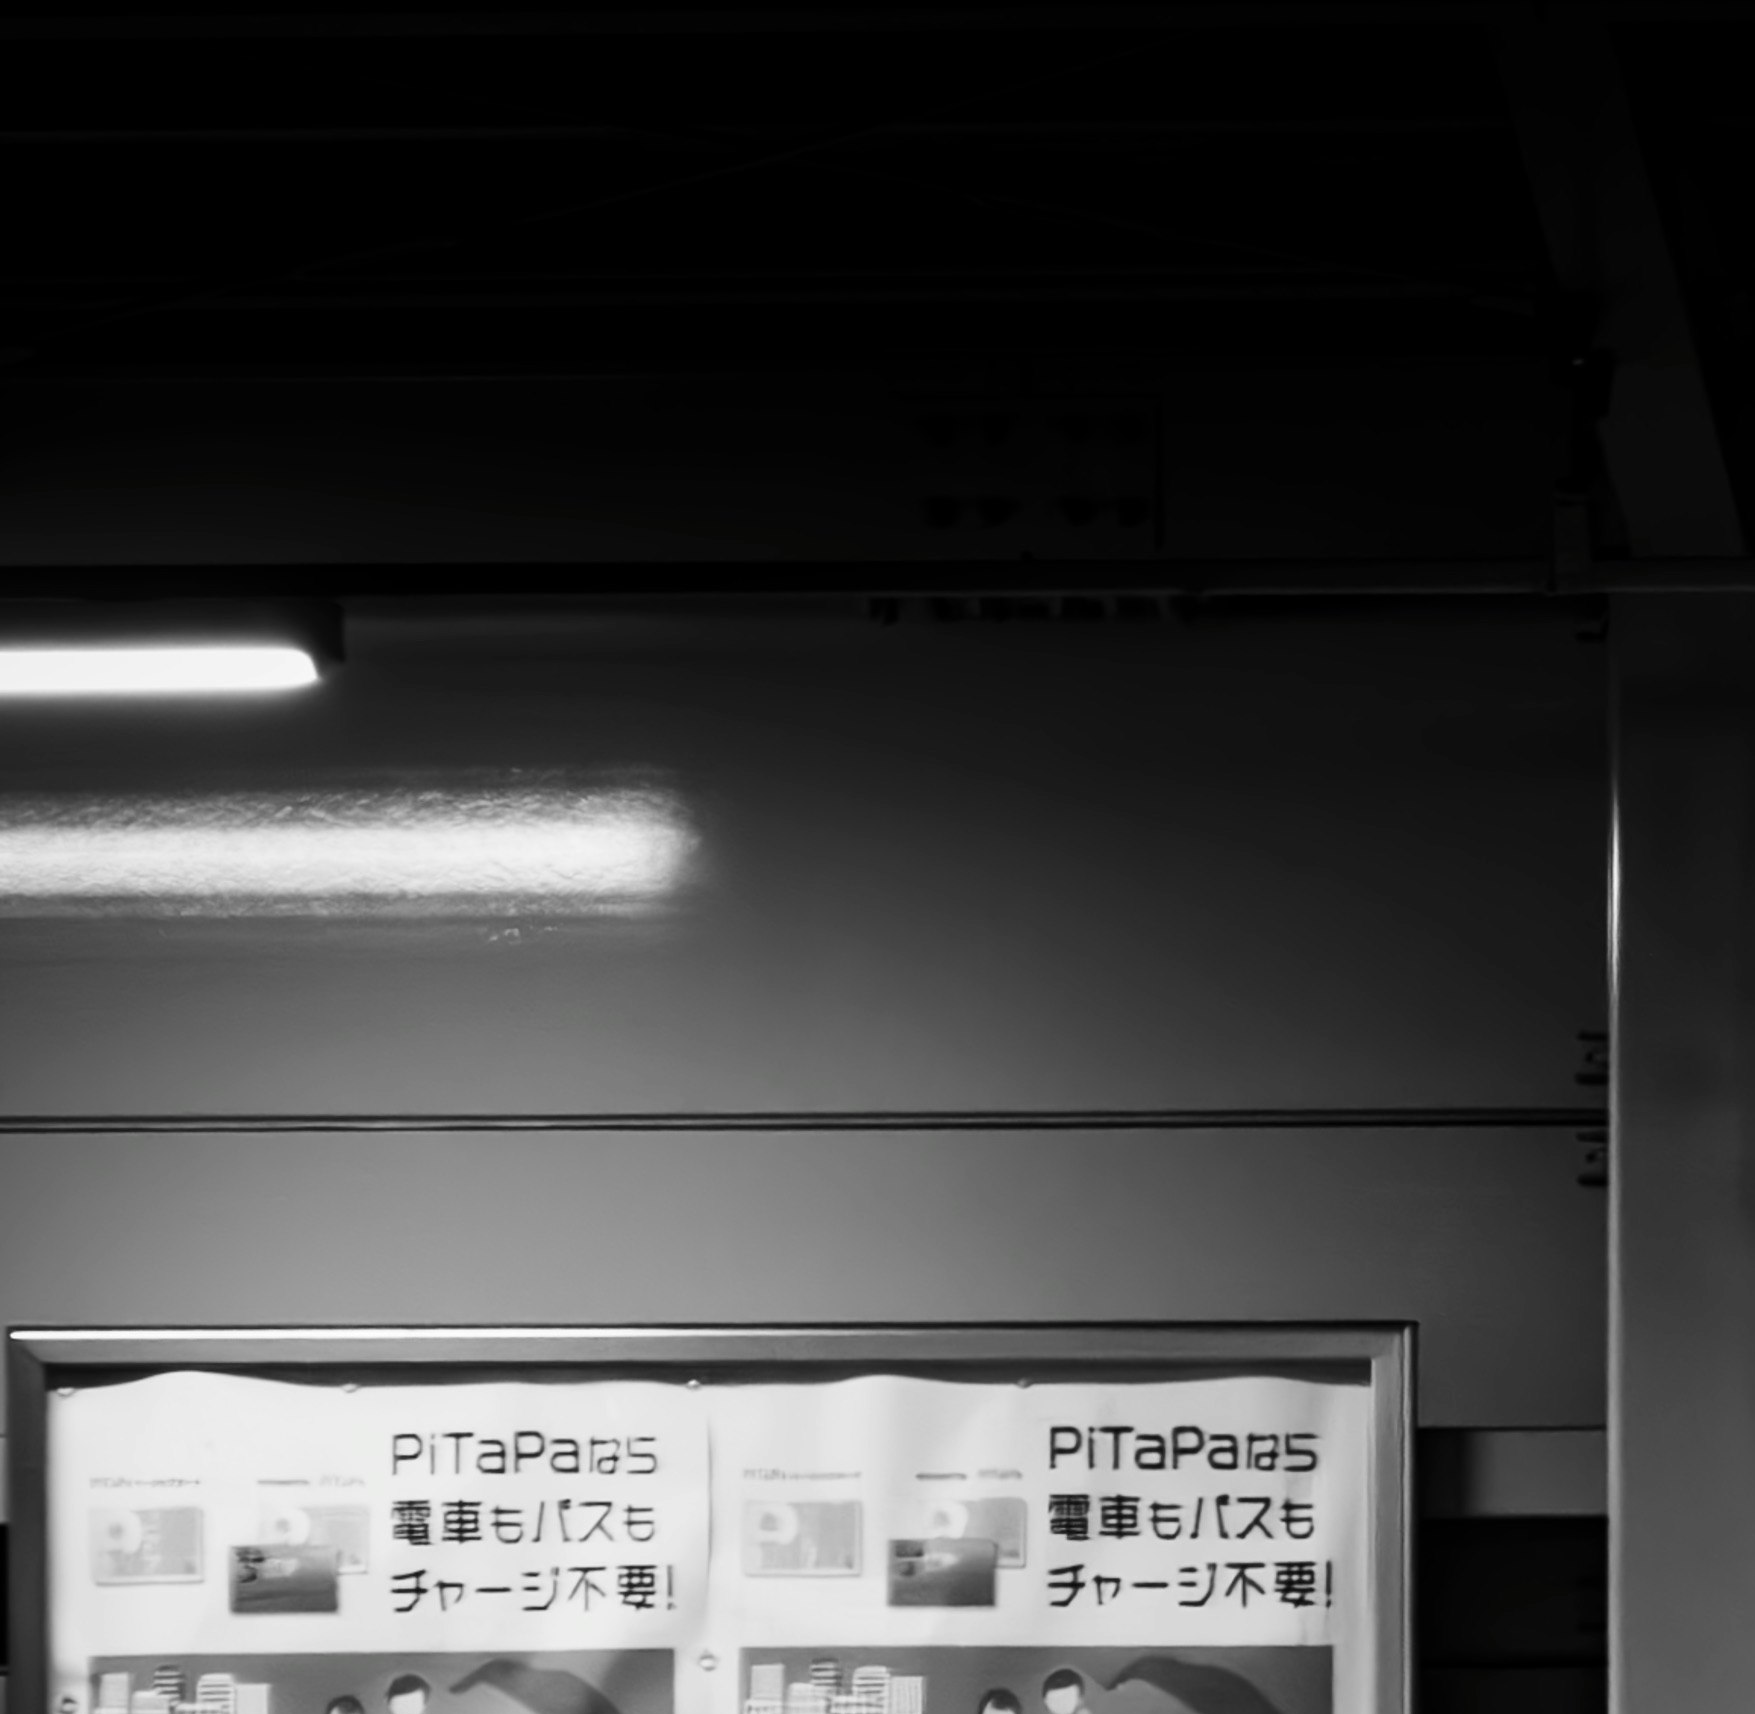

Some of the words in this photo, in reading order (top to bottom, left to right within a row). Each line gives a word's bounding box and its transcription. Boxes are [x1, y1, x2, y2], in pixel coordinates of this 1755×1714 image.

[393, 1430, 658, 1475] PiTaPaなら
[1049, 1425, 1320, 1473] PiTaPaなら
[392, 1498, 655, 1546] 電車もバスも
[1047, 1493, 1315, 1542] 電車もバスも
